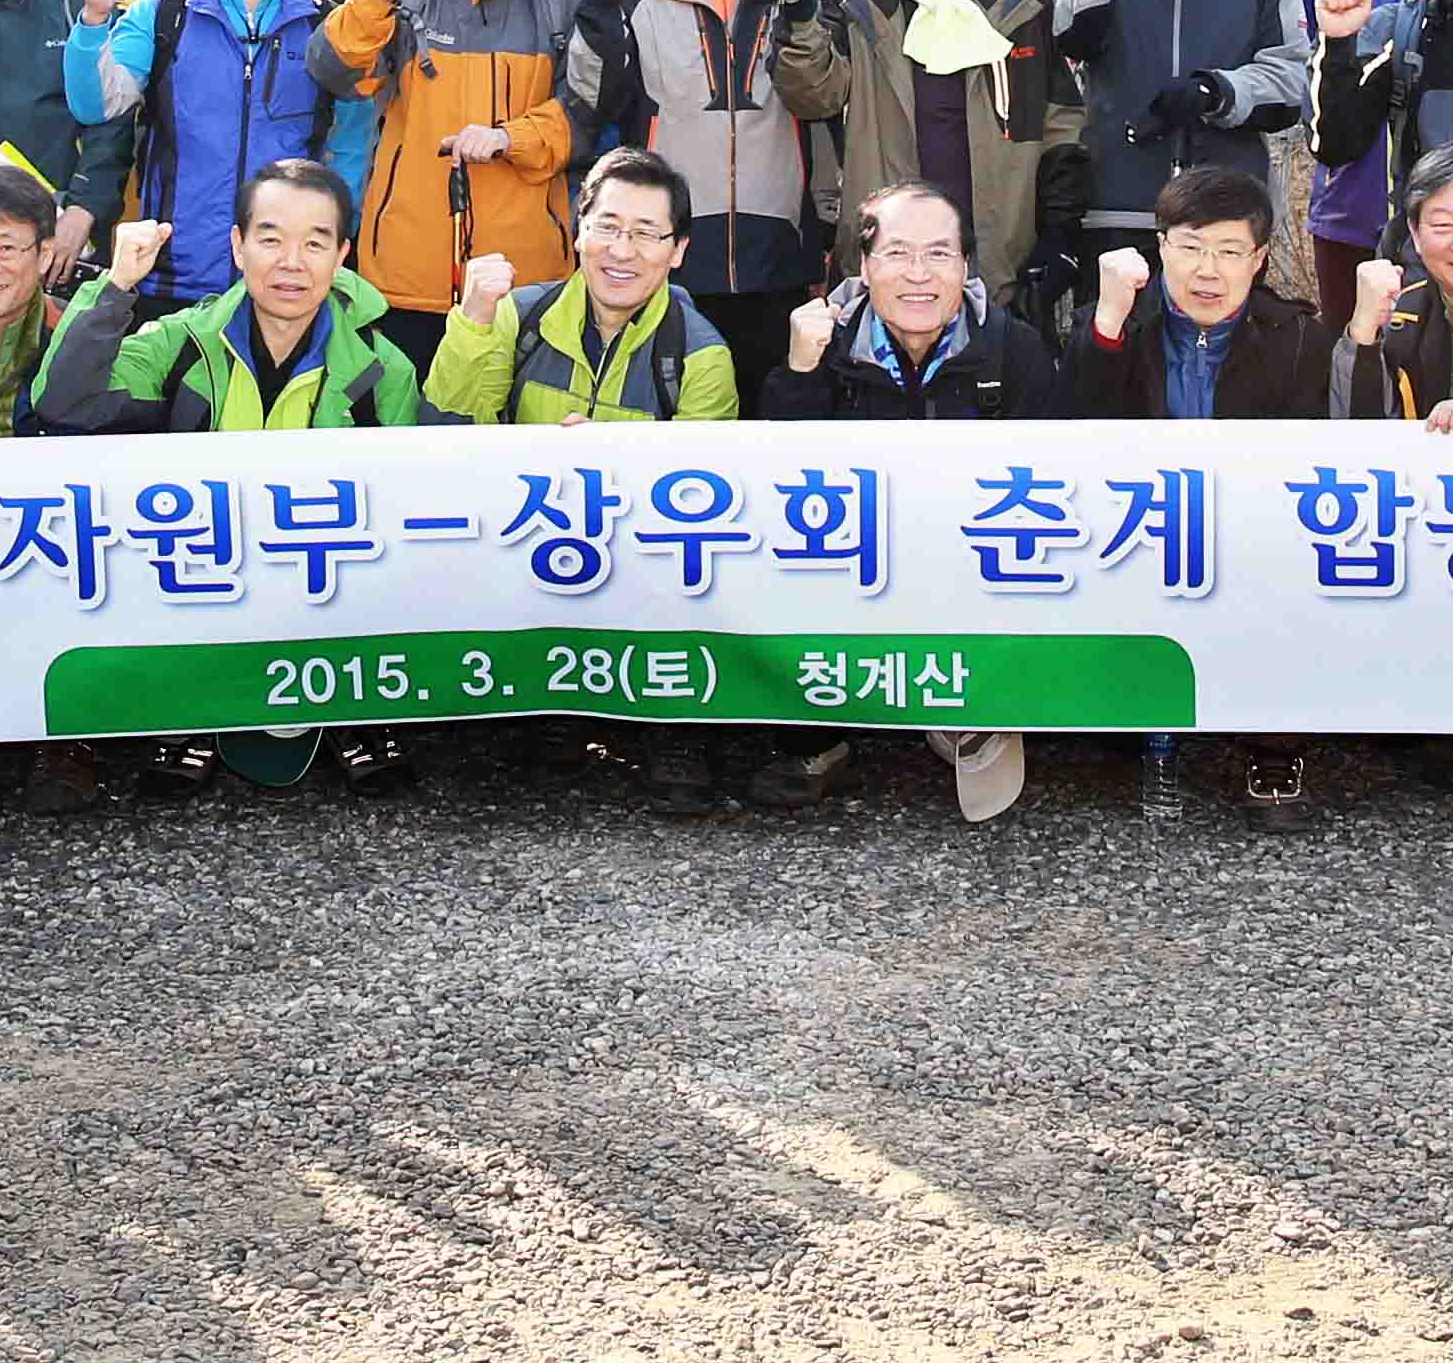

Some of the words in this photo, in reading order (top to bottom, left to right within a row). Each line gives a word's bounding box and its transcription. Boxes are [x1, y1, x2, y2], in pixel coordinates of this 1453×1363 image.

[961, 466, 1206, 589] 춘계
[265, 653, 430, 706] 2015.
[460, 650, 515, 697] 3.
[546, 645, 718, 704] 28(토)
[796, 651, 970, 708] 청계산
